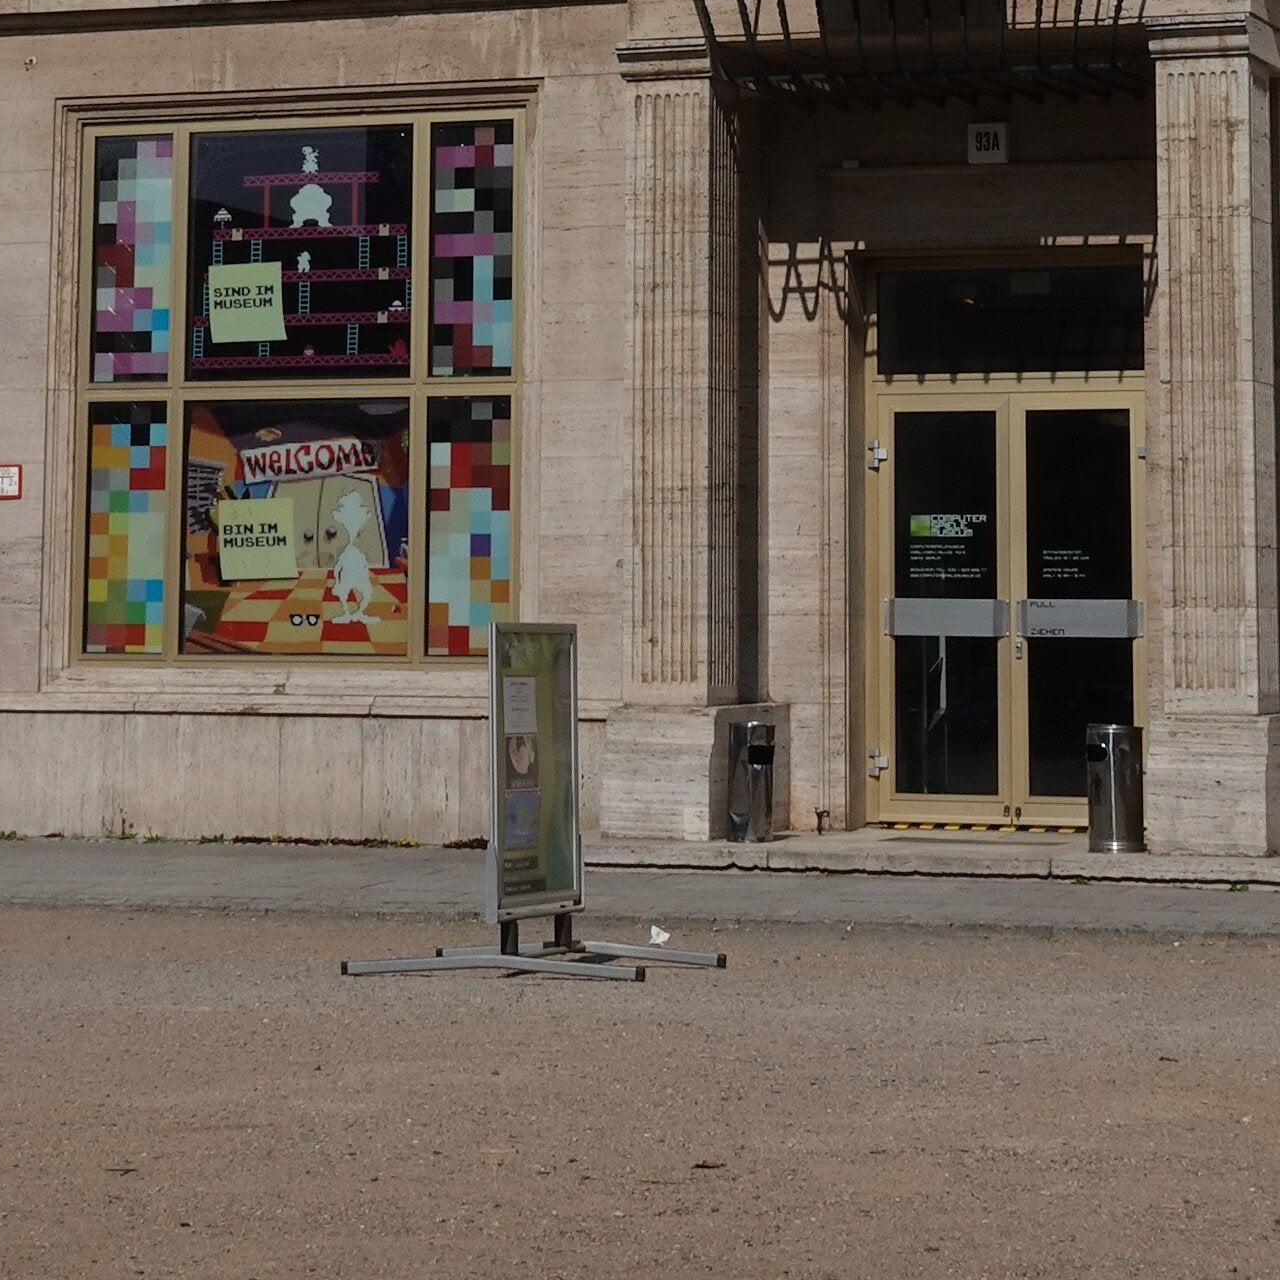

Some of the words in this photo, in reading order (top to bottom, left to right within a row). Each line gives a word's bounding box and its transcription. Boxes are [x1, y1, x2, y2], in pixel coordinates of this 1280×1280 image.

[975, 130, 1001, 152] 93A
[213, 286, 252, 298] SIND
[255, 284, 275, 296] IM
[213, 296, 274, 310] MUSEUM
[930, 513, 988, 523] COMPUTER
[223, 523, 254, 536] BIN
[258, 522, 279, 535] IM
[223, 535, 287, 549] MUSEUM
[1029, 600, 1055, 609] PULL
